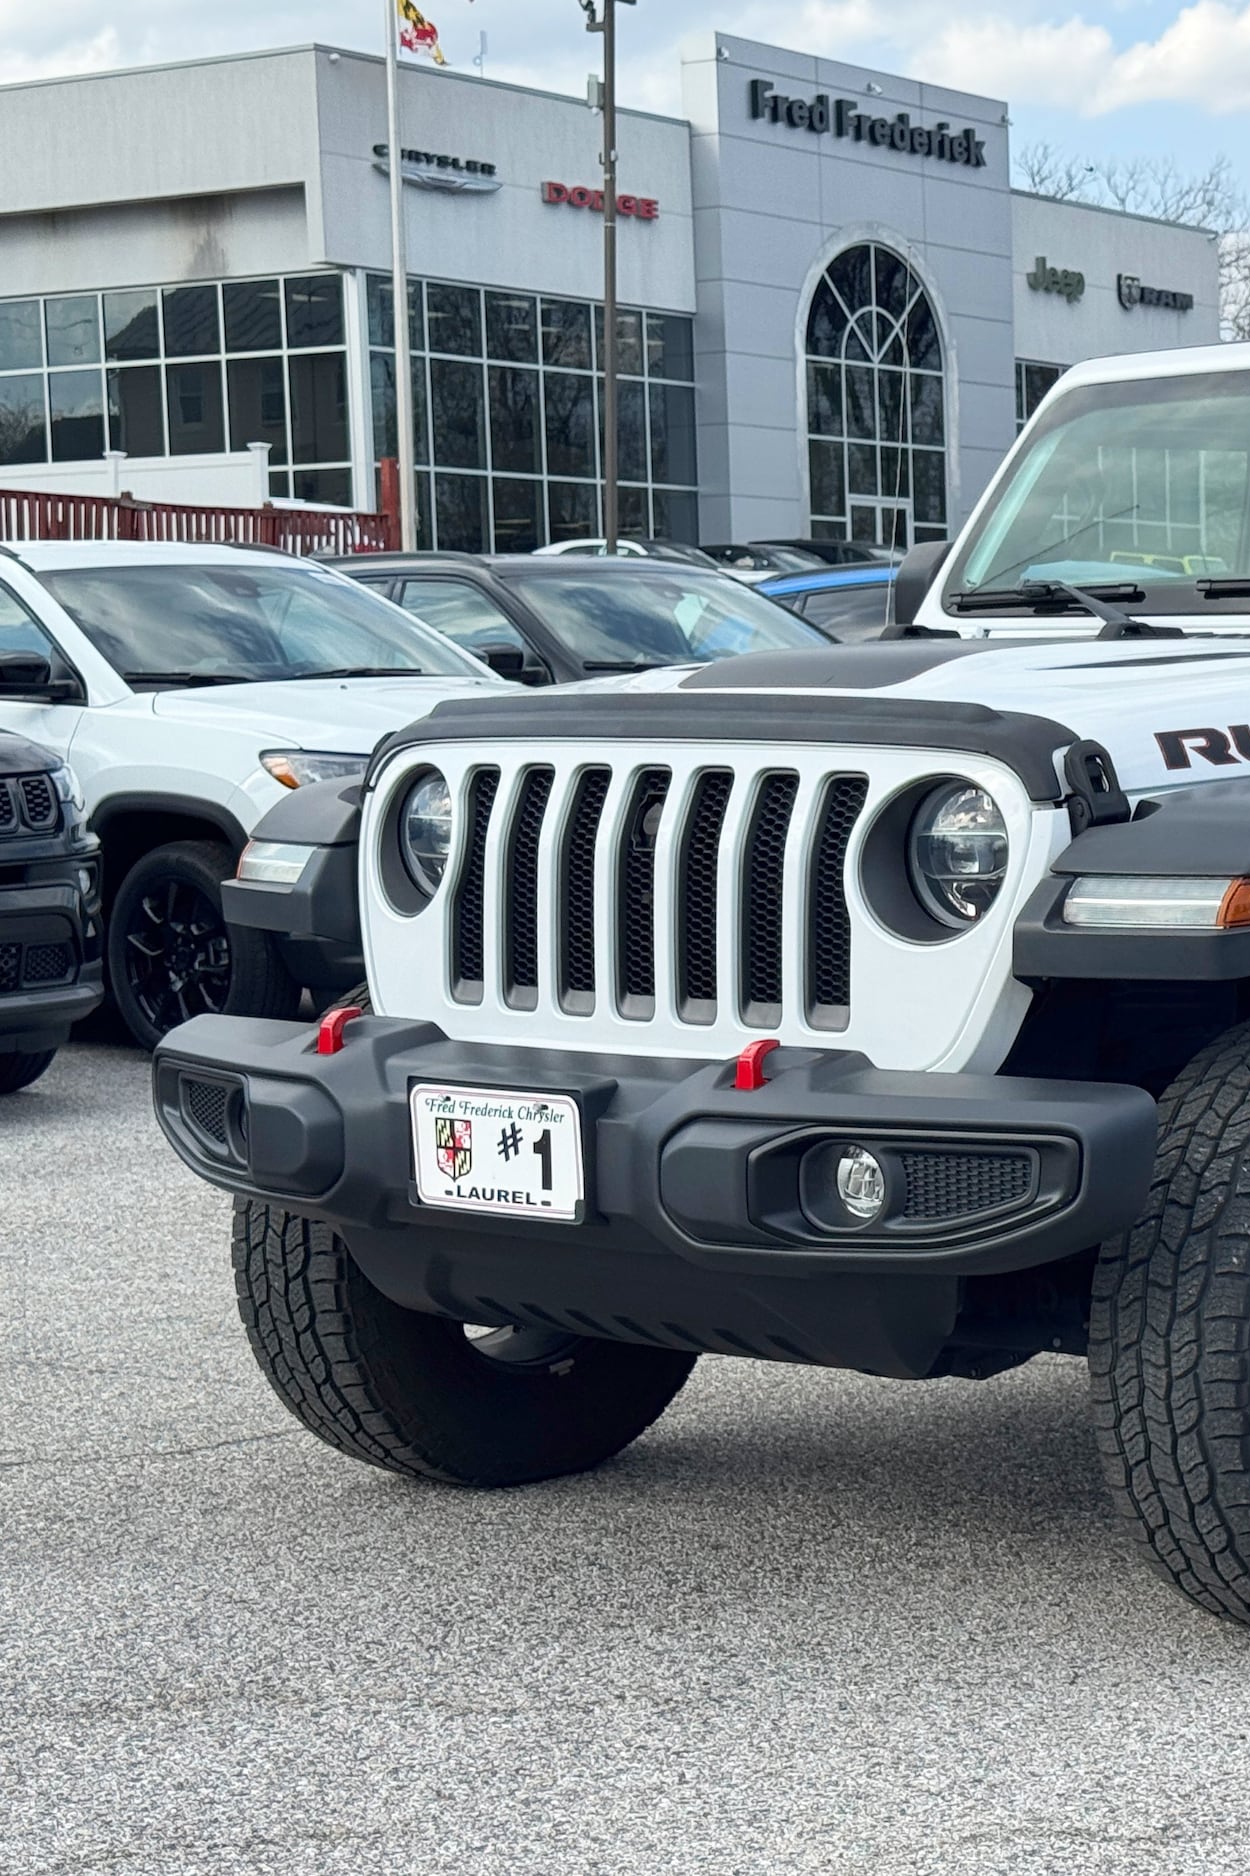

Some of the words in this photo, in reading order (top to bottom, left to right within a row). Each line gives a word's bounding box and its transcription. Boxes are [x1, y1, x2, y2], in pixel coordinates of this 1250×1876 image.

[748, 79, 830, 133] Fred
[834, 99, 987, 167] Frederick
[541, 182, 659, 220] DODGE
[1026, 256, 1085, 304] Jeep
[1141, 286, 1194, 311] RAM
[425, 1096, 455, 1115] Fred
[459, 1100, 514, 1120] Frederick
[517, 1104, 566, 1124] Chrysler
